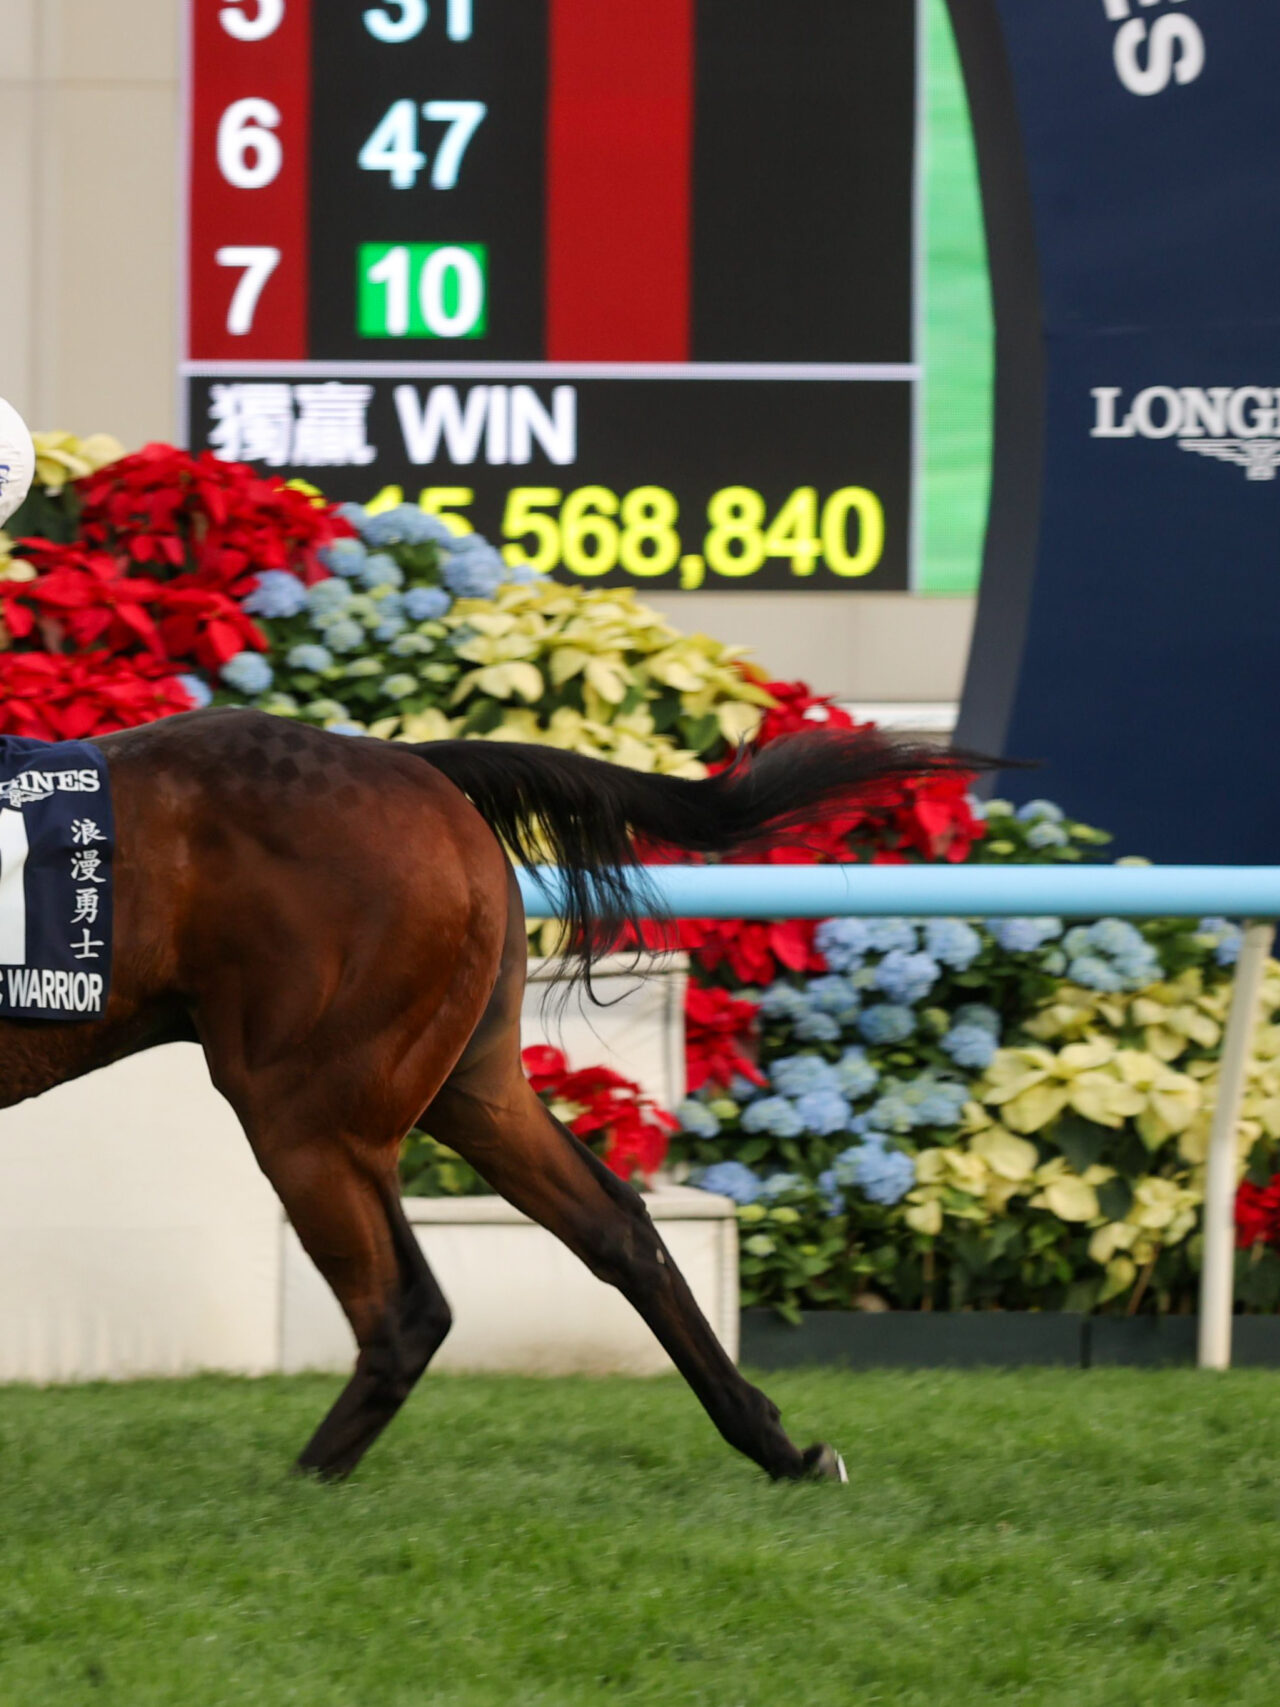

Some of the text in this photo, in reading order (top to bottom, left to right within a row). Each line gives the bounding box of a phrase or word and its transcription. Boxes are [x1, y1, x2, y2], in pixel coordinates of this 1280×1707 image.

[216, 97, 486, 190] 6 47
[215, 246, 484, 337] 7 10
[393, 384, 577, 466] WIN
[1090, 385, 1280, 438] LONG
[69, 818, 108, 960] 浪漫勇士
[7, 969, 104, 1012] WARRIOR
